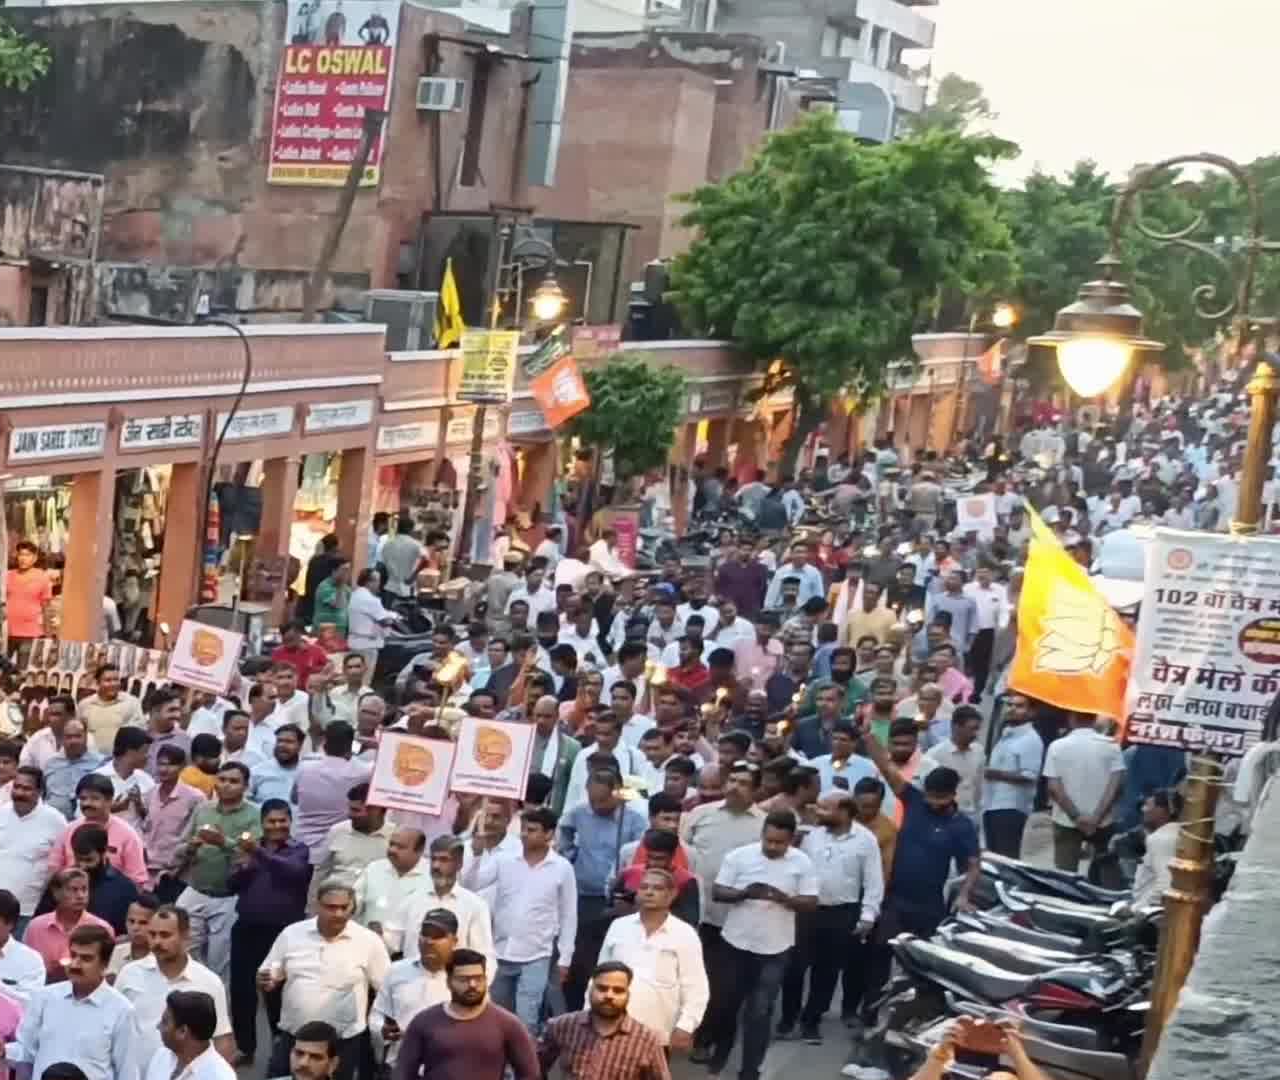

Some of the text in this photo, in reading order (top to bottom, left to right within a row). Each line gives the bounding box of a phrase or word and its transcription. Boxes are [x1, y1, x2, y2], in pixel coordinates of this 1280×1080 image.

[285, 48, 386, 75] LC OSWAL
[1154, 588, 1198, 606] 102
[1151, 655, 1190, 686] चैत्र
[1195, 661, 1245, 692] मेले
[1137, 691, 1222, 719] लख-लख
